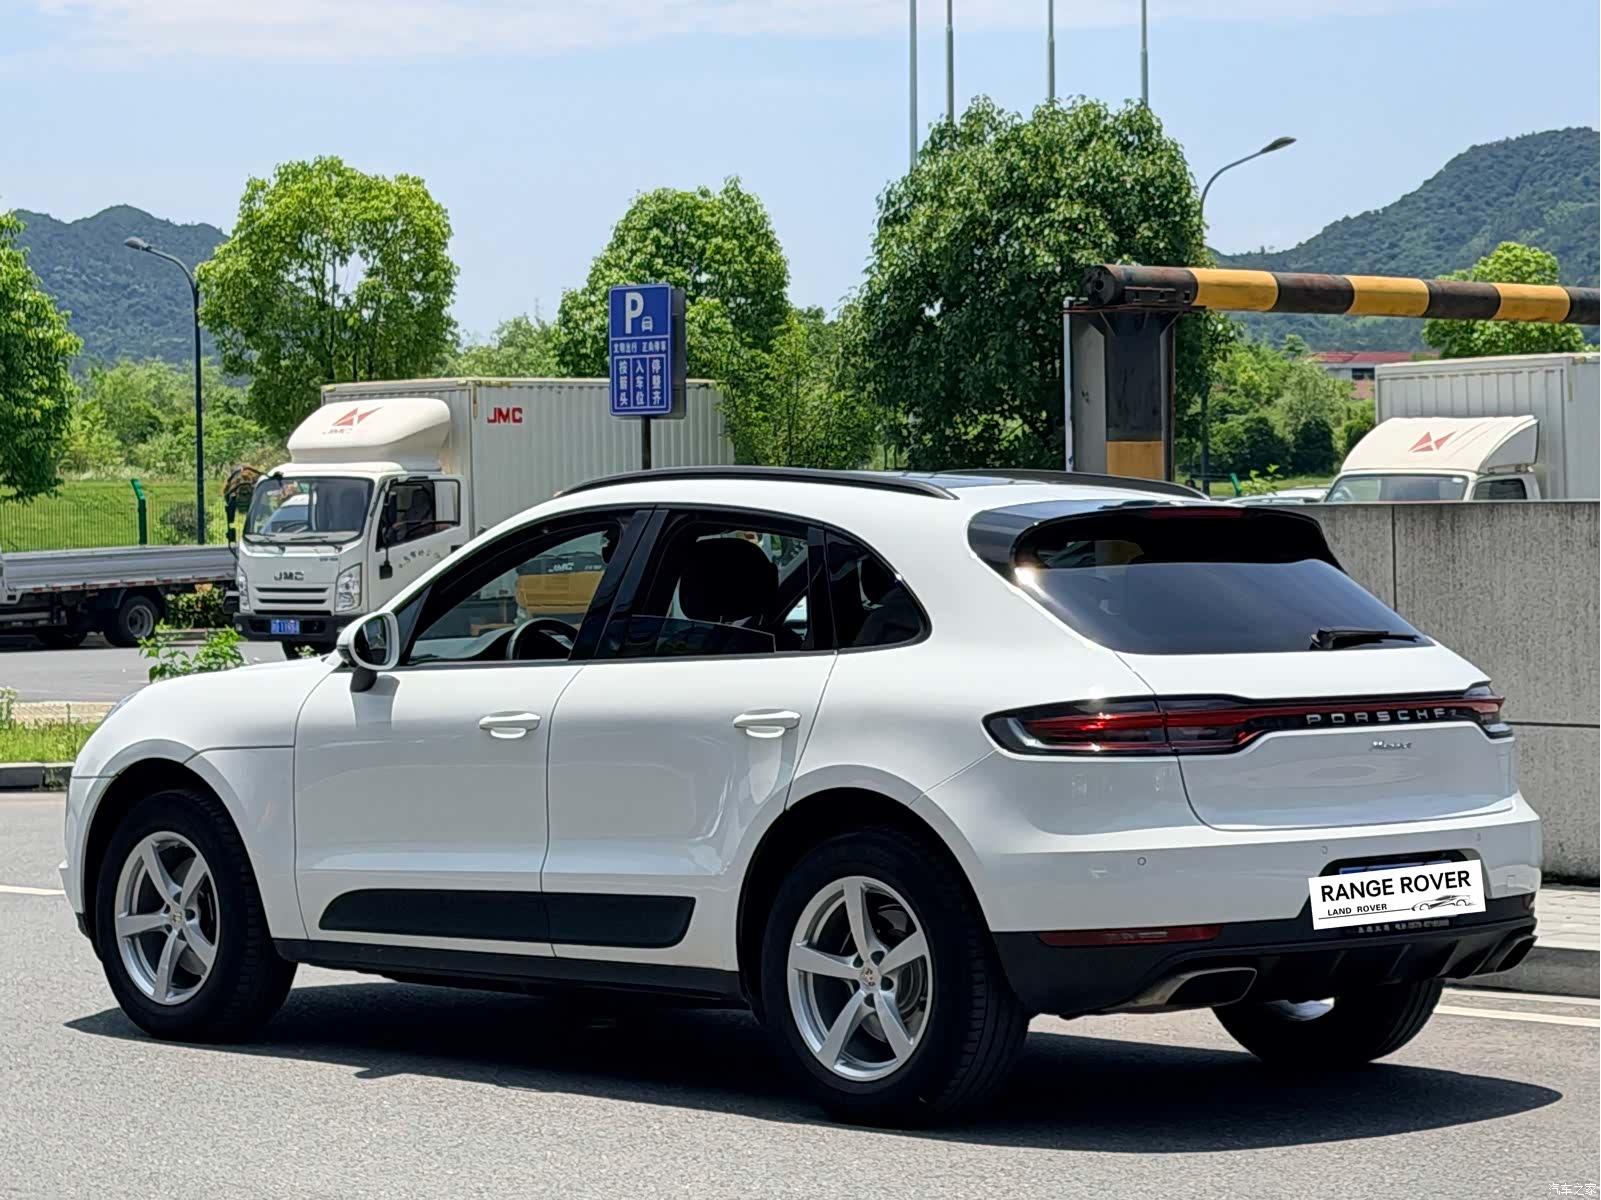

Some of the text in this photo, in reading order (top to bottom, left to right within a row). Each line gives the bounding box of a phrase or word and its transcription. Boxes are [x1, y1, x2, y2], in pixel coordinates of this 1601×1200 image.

[625, 291, 644, 334] P
[635, 359, 645, 406] 入车位
[487, 407, 523, 424] JMC
[273, 571, 304, 581] JMC
